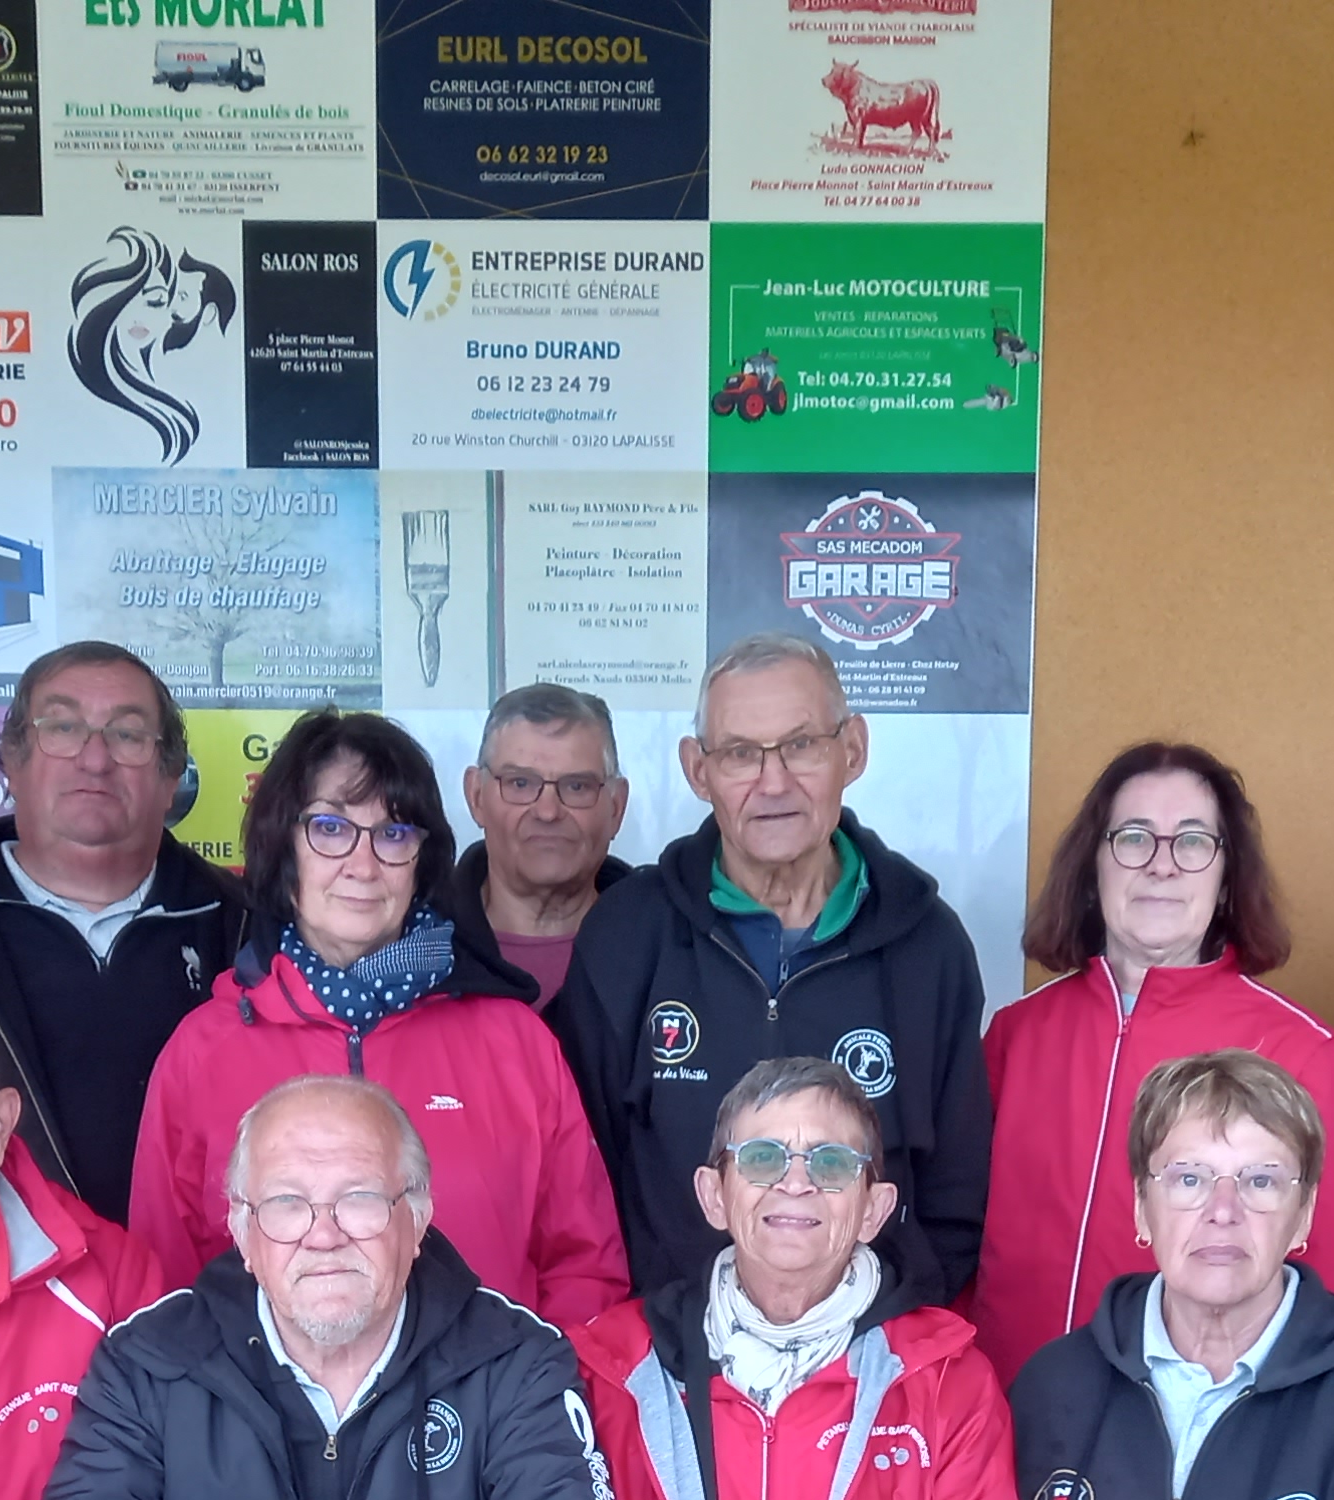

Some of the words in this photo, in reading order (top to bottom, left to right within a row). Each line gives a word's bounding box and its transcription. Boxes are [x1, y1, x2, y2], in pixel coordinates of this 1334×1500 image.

[854, 23, 865, 31] DE
[177, 53, 207, 61] FIOUL
[438, 36, 508, 63] EURL
[517, 36, 648, 64] DECOSOL
[430, 80, 509, 93] CARRELAGE
[517, 80, 572, 93] FAIENCE
[579, 80, 621, 94] BETON
[625, 79, 655, 94] CIRÉ
[423, 97, 472, 111] RESINES
[476, 98, 493, 111] DE
[497, 98, 528, 111] SOLS
[536, 98, 599, 111] PLATRERIE
[603, 98, 661, 111] PEINTURE
[65, 103, 105, 118] Fioul
[110, 104, 202, 122] Domestique
[218, 103, 289, 120] Granulés
[295, 105, 313, 119] de
[318, 105, 350, 120] bois
[183, 131, 243, 139] ANIMALERIE
[477, 145, 502, 163] 06
[508, 145, 529, 163] 62
[535, 146, 557, 163] 32
[563, 146, 580, 163] 19
[586, 146, 608, 164] 23
[821, 164, 848, 175] Ludo
[850, 164, 924, 175] GONNACHON
[751, 180, 780, 191] Place
[782, 180, 814, 191] Pierre
[867, 180, 895, 191] Saint
[897, 180, 934, 191] Martin
[261, 253, 318, 271] SALON
[323, 254, 358, 271] ROS
[472, 252, 606, 271] ENTREPRISE
[614, 252, 704, 272] DURAND
[471, 278, 571, 299] ÉLECTRICITÉ
[577, 280, 659, 299] GÉNÉRALE
[763, 279, 844, 296] Jean-Luc
[849, 280, 990, 297] MOTOCULTURE
[814, 311, 855, 321] VENTES
[864, 311, 938, 322] REPARATIONS
[765, 327, 824, 337] MATERIELS
[826, 327, 886, 338] AGRICOLES
[889, 328, 901, 338] ET
[905, 328, 951, 339] ESPACES
[953, 328, 985, 339] VERTS
[467, 340, 528, 358] Bruno
[535, 341, 621, 359] DURAND
[477, 376, 501, 392] 06
[507, 376, 525, 392] 12
[531, 376, 552, 392] 23
[559, 376, 581, 392] 24
[588, 377, 610, 392] 79
[798, 371, 825, 386] Tel:
[829, 372, 951, 387] 04.70.31.27.54
[792, 393, 954, 413] jlmotoc@gmail.com
[471, 408, 617, 423] dbelectricite@hotmail.fr
[431, 436, 451, 445] rue
[455, 434, 505, 446] Winston
[509, 434, 559, 446] Churchill
[571, 436, 608, 446] 03120
[613, 436, 675, 447] LAPALISSE
[93, 482, 223, 516] MERCIER
[231, 484, 338, 522] Sylvain
[583, 503, 640, 513] RAYMOND
[546, 547, 601, 560] Peinture
[612, 547, 682, 560] Décoration
[817, 541, 845, 553] SAS
[851, 541, 923, 554] MECADOM
[110, 550, 213, 578] Abattage
[233, 552, 326, 579] Elagage
[545, 565, 615, 580] Placoplâtre
[628, 566, 683, 578] Isolation
[789, 560, 950, 599] GARAGE
[120, 584, 167, 607] Bois
[175, 585, 203, 608] de
[209, 586, 321, 614] chauffage
[829, 613, 864, 636] DUMAS
[871, 615, 908, 636] CYRIL
[663, 1028, 679, 1049] 7
